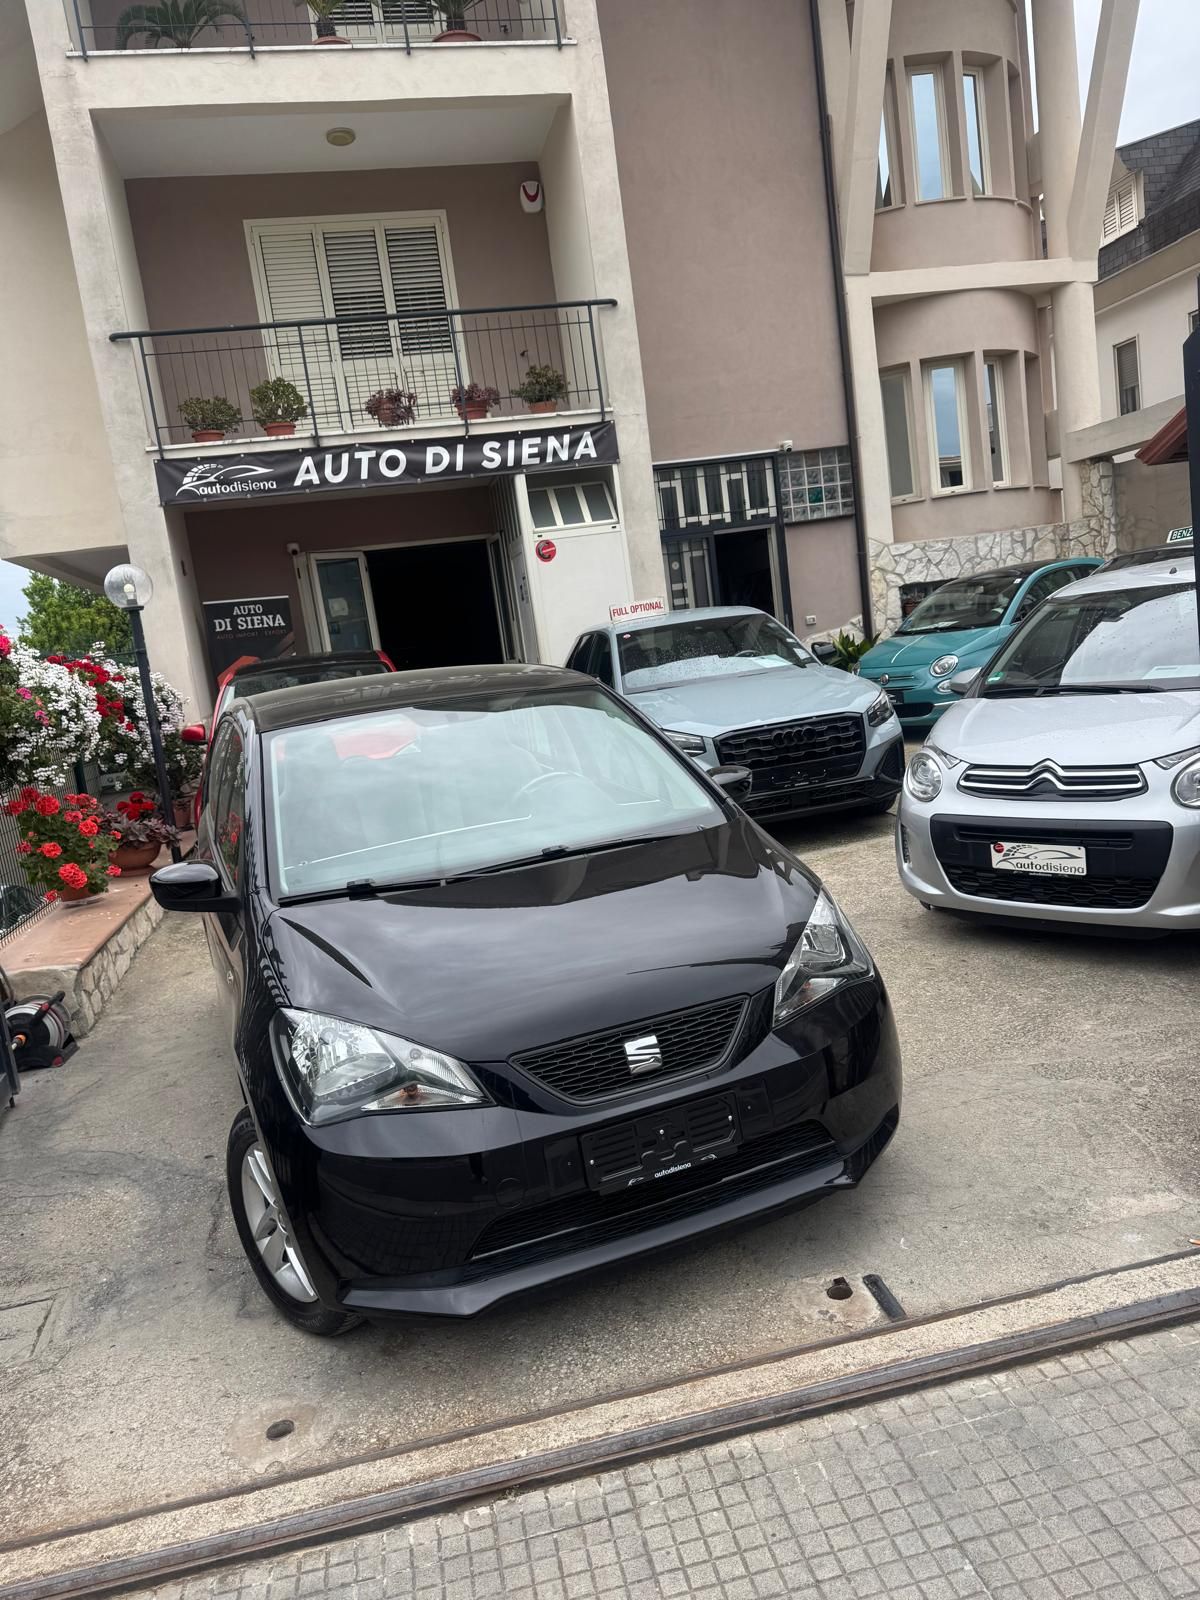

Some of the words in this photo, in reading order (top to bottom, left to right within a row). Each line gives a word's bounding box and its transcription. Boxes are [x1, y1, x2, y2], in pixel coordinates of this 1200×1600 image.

[293, 448, 407, 487] AUTO
[425, 443, 464, 474] DI
[481, 431, 598, 469] SIENA
[199, 480, 277, 496] autodisiena
[233, 603, 263, 616] AUTO
[612, 606, 630, 617] FULL
[630, 601, 664, 614] OPTIONAL
[213, 618, 233, 632] DI
[236, 613, 286, 630] SIENA
[1015, 861, 1085, 874] autodisiena
